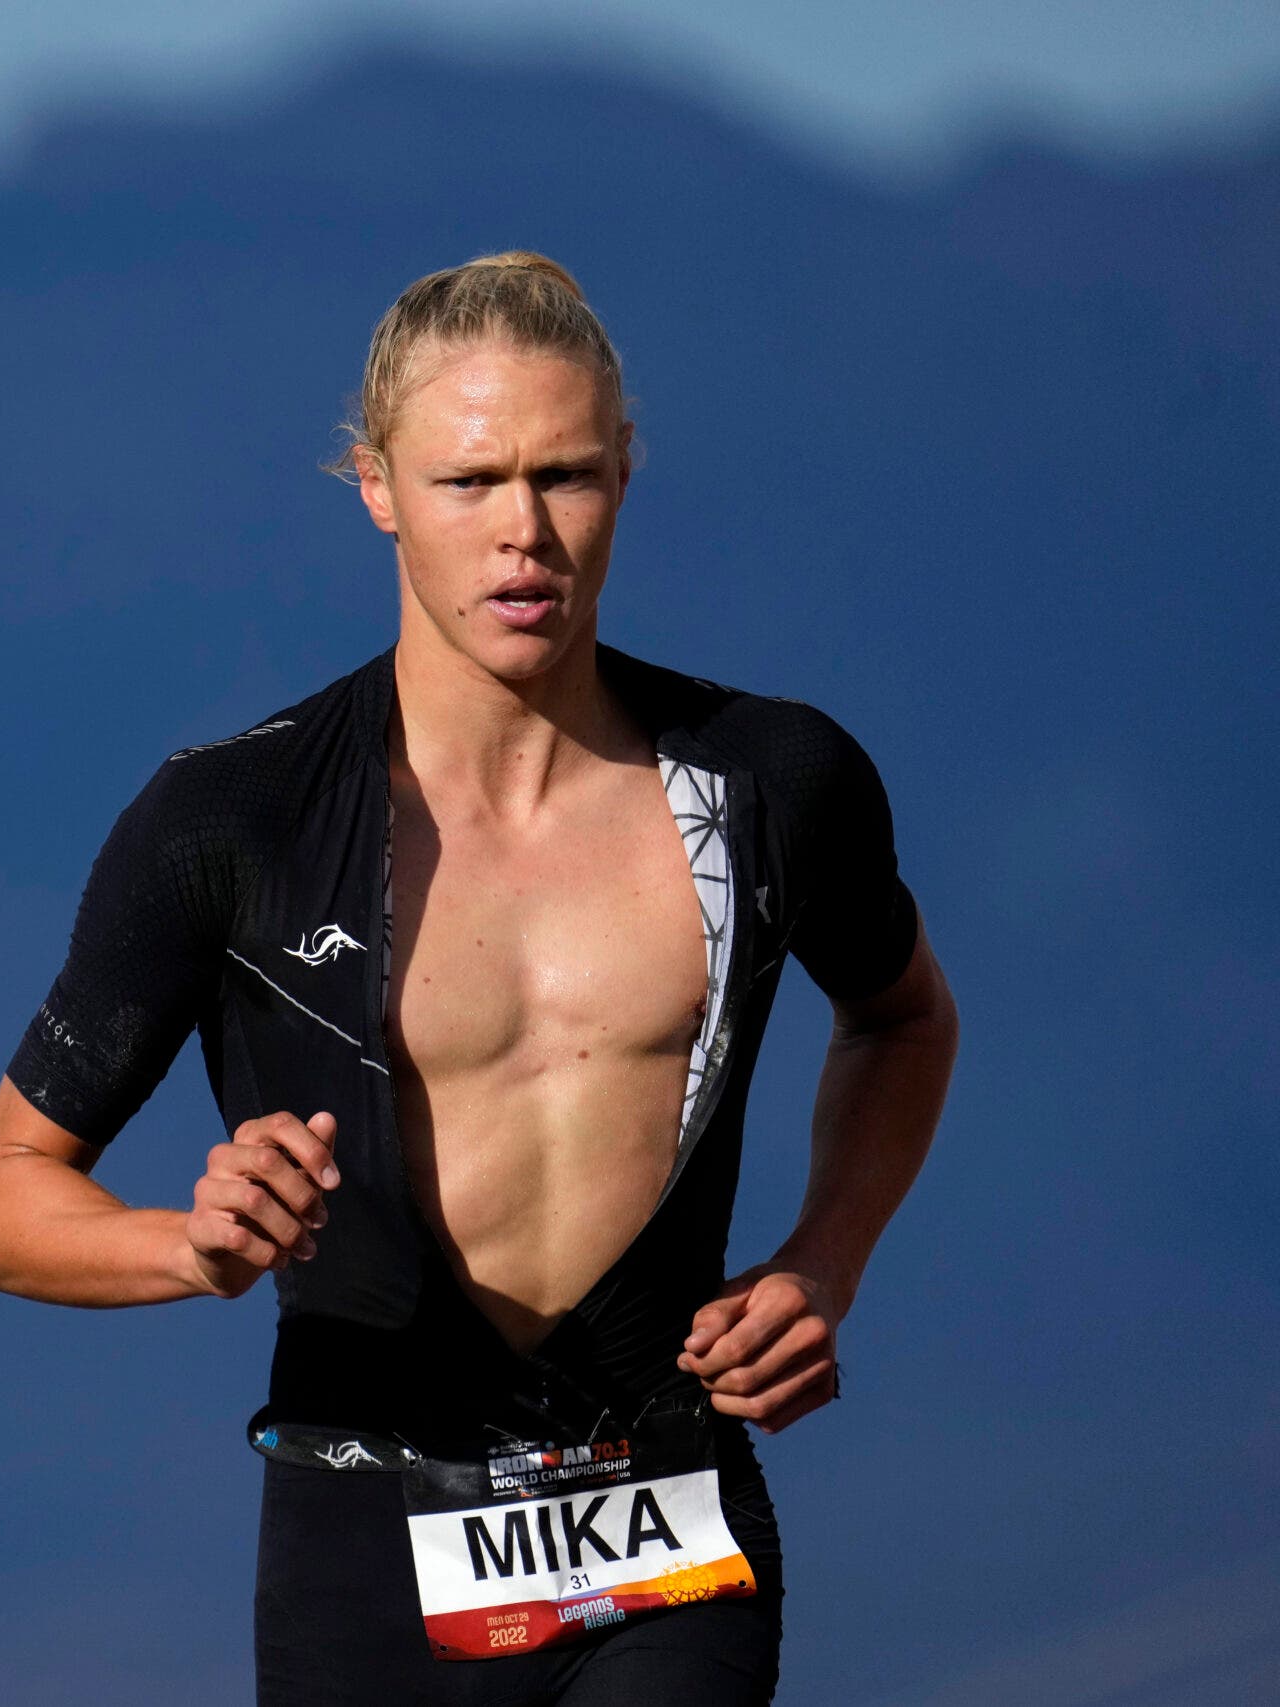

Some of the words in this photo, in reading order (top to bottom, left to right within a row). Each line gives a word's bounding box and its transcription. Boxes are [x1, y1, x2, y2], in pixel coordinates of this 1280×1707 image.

[592, 1439, 631, 1462] 70.3
[491, 1472, 538, 1490] WORLD
[541, 1458, 631, 1483] CHAMPIONSHIP
[462, 1488, 683, 1581] MIKA
[570, 1573, 591, 1590] 31
[504, 1613, 519, 1625] OCT
[519, 1612, 529, 1623] 29
[488, 1626, 528, 1648] 2022
